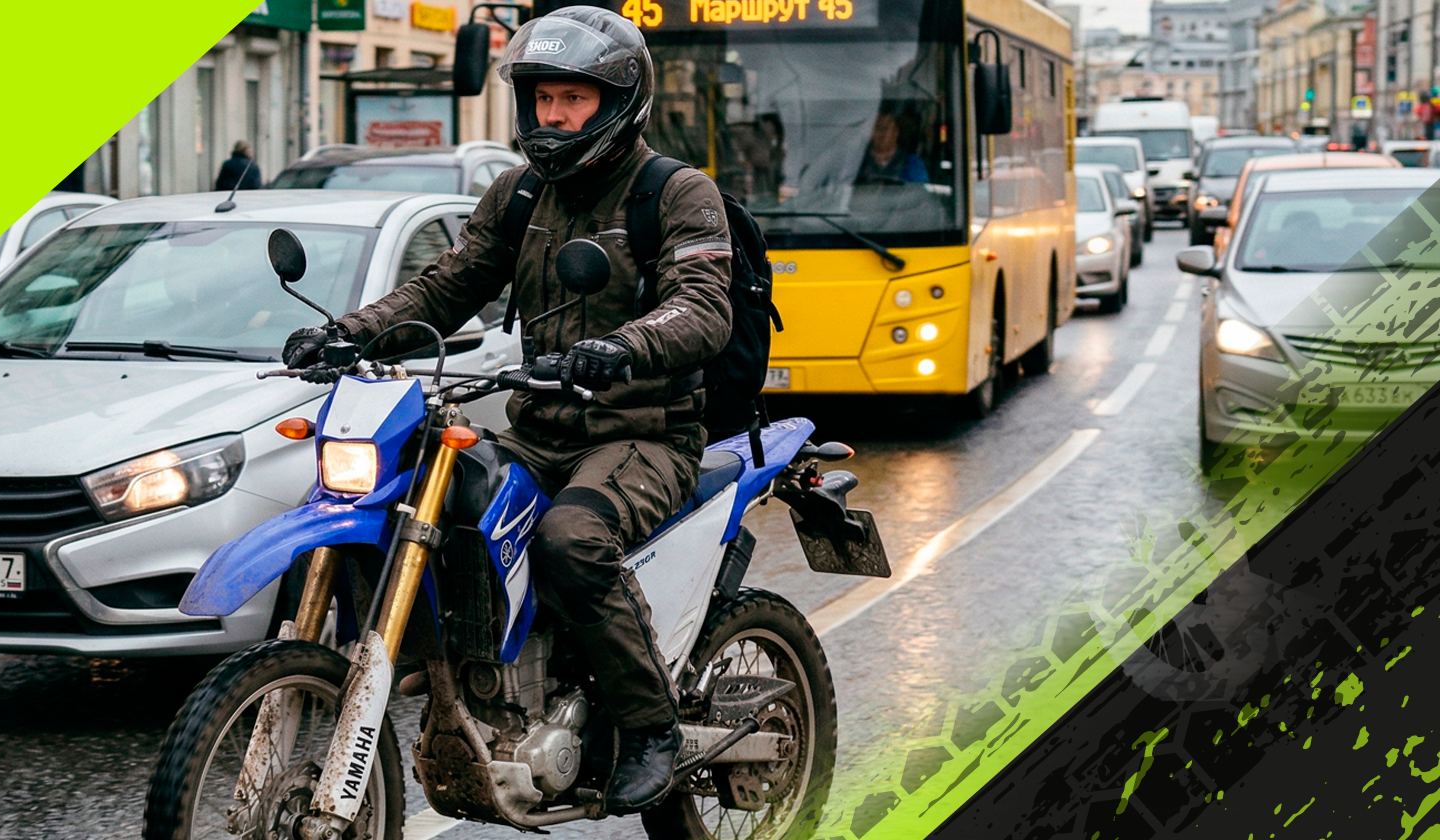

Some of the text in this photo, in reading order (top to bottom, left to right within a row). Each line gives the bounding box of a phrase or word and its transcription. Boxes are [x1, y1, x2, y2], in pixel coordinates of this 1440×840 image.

[622, 0, 854, 27] 45 Маршрут 45
[528, 40, 561, 51] SHOEI
[340, 726, 376, 800] YAMAHA
